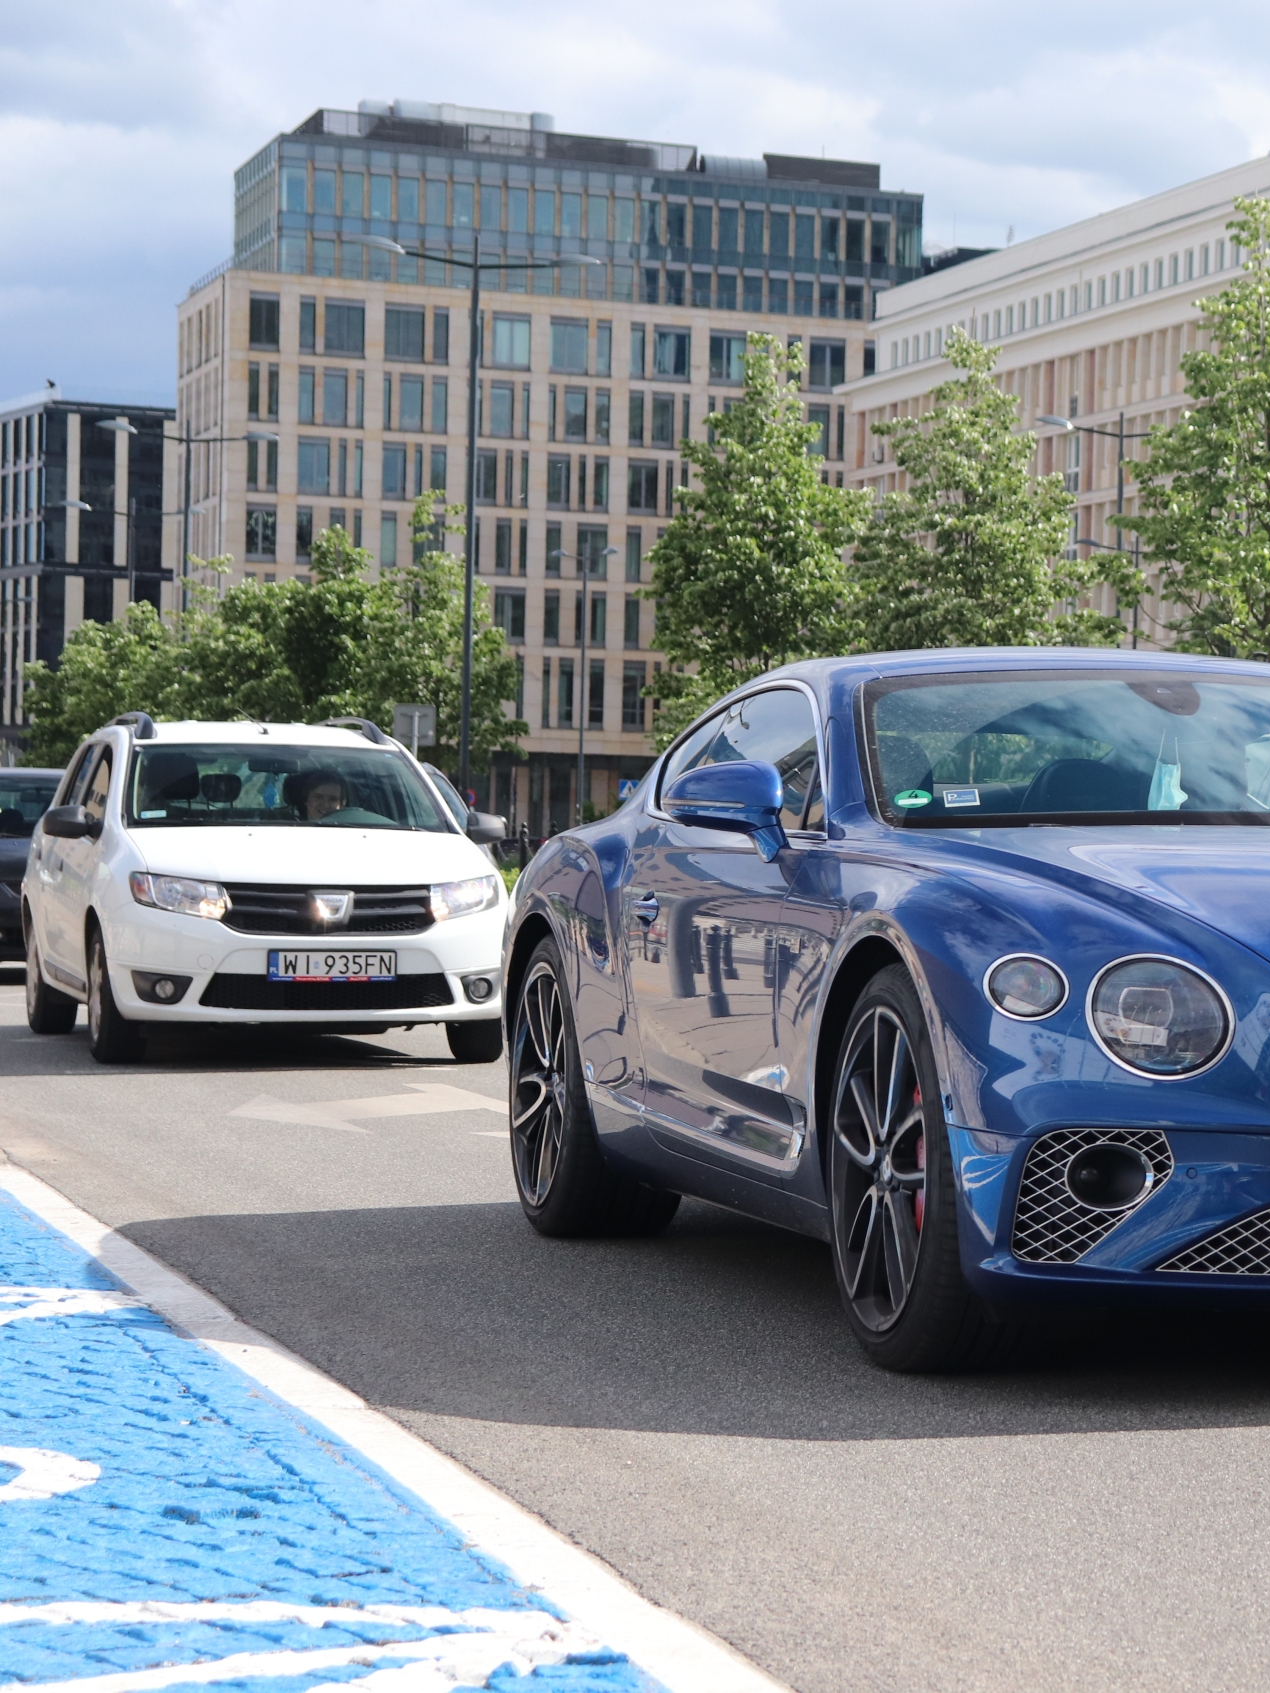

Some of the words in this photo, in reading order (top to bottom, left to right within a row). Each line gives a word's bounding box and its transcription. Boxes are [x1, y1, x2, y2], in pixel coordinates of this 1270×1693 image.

[908, 790, 919, 798] 4
[283, 954, 310, 975] WI
[324, 954, 392, 975] 935FN
